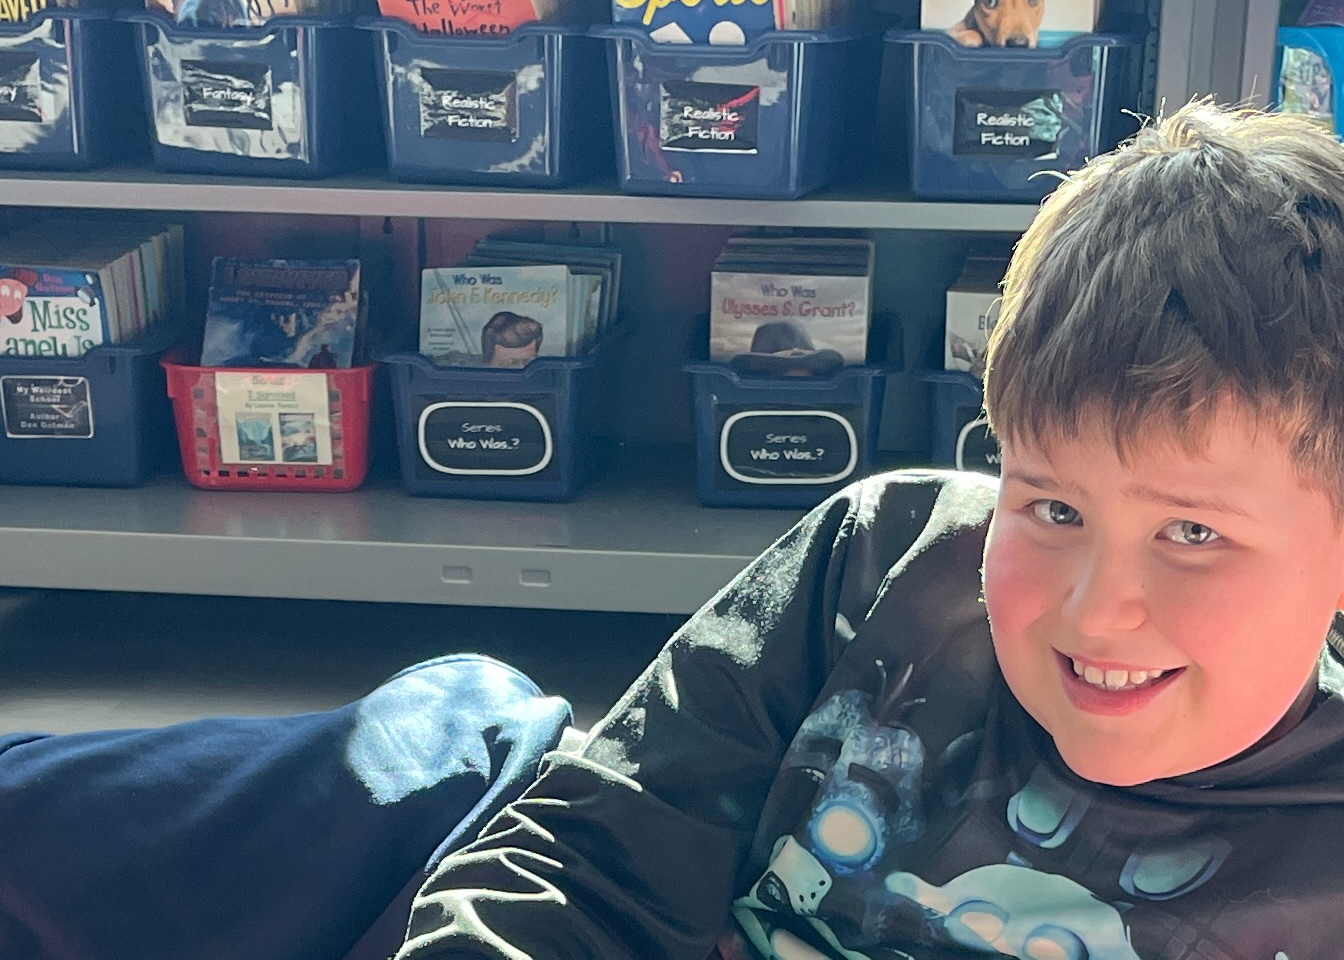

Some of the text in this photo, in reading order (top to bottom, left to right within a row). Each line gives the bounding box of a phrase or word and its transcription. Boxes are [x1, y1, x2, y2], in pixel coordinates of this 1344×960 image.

[202, 86, 256, 107] Fantasy
[441, 94, 496, 111] Realistic
[683, 105, 740, 122] Realistic
[975, 112, 1035, 128] Realistic
[448, 115, 494, 129] Fiction
[687, 126, 736, 142] Fiction
[980, 132, 1032, 147] Fiction
[452, 273, 503, 286] Who Was
[427, 288, 467, 306] John
[483, 285, 560, 308] Kennedy?
[760, 283, 817, 299] Who Was
[26, 298, 91, 333] Miss
[721, 297, 778, 319] Ulysses
[798, 300, 856, 318] Grant?
[461, 422, 503, 433] Series
[447, 437, 476, 450] Who
[765, 433, 808, 444] Series
[749, 448, 780, 461] Who
